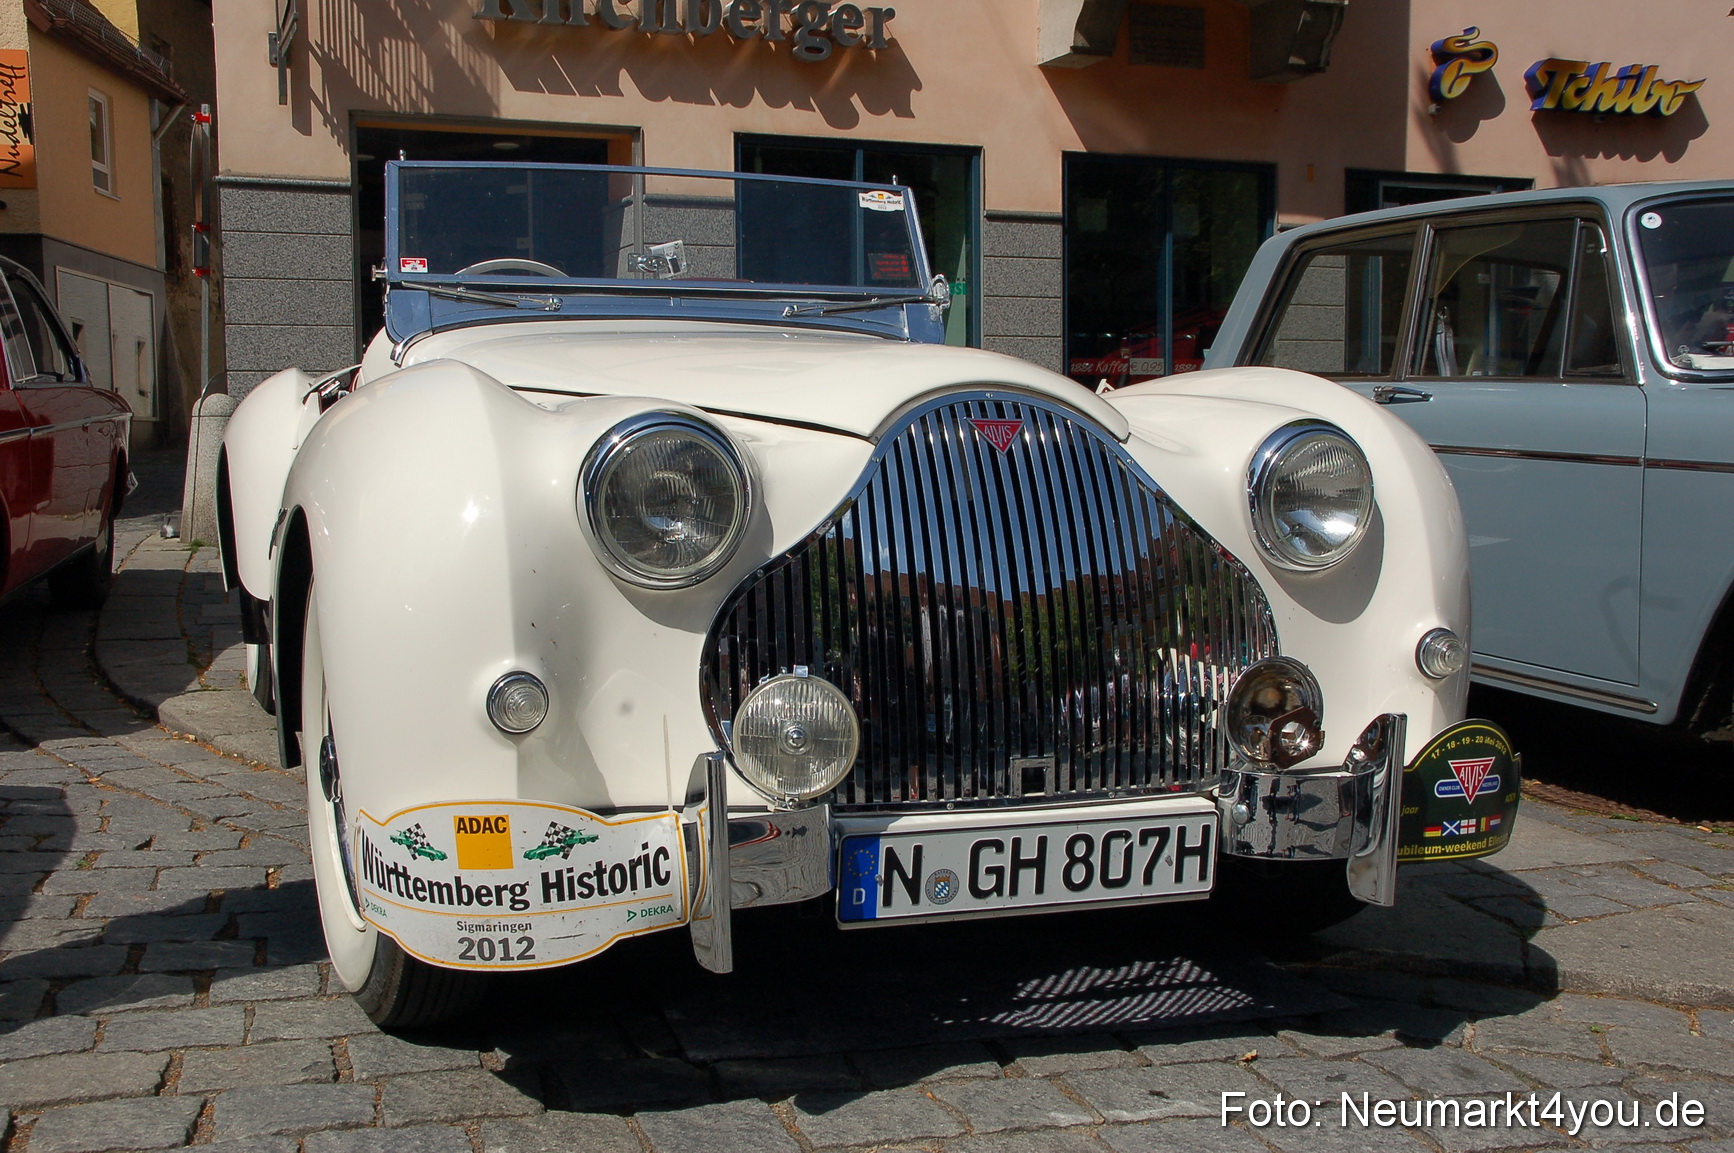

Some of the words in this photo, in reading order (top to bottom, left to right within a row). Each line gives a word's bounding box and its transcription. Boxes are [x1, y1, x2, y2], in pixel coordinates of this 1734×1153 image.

[1525, 57, 1706, 116] Tchibo
[1095, 360, 1129, 374] Kaffee
[1141, 361, 1163, 373] 0,95
[984, 425, 1012, 447] ALVIS
[1431, 748, 1440, 759] 17
[1446, 741, 1456, 749] 18
[1459, 765, 1484, 795] ALVIS
[1401, 805, 1419, 817] jaar
[457, 817, 507, 834] ADAC
[1397, 839, 1487, 856] ubileum-weekend
[361, 827, 531, 911] Württemberg
[541, 842, 671, 903] Historic
[882, 844, 923, 907] N
[968, 835, 1048, 899] GH
[1062, 823, 1212, 893] 807H
[853, 888, 865, 905] D
[641, 904, 674, 918] DEKRA
[457, 921, 532, 933] Sigmaringen
[458, 937, 536, 961] 2012
